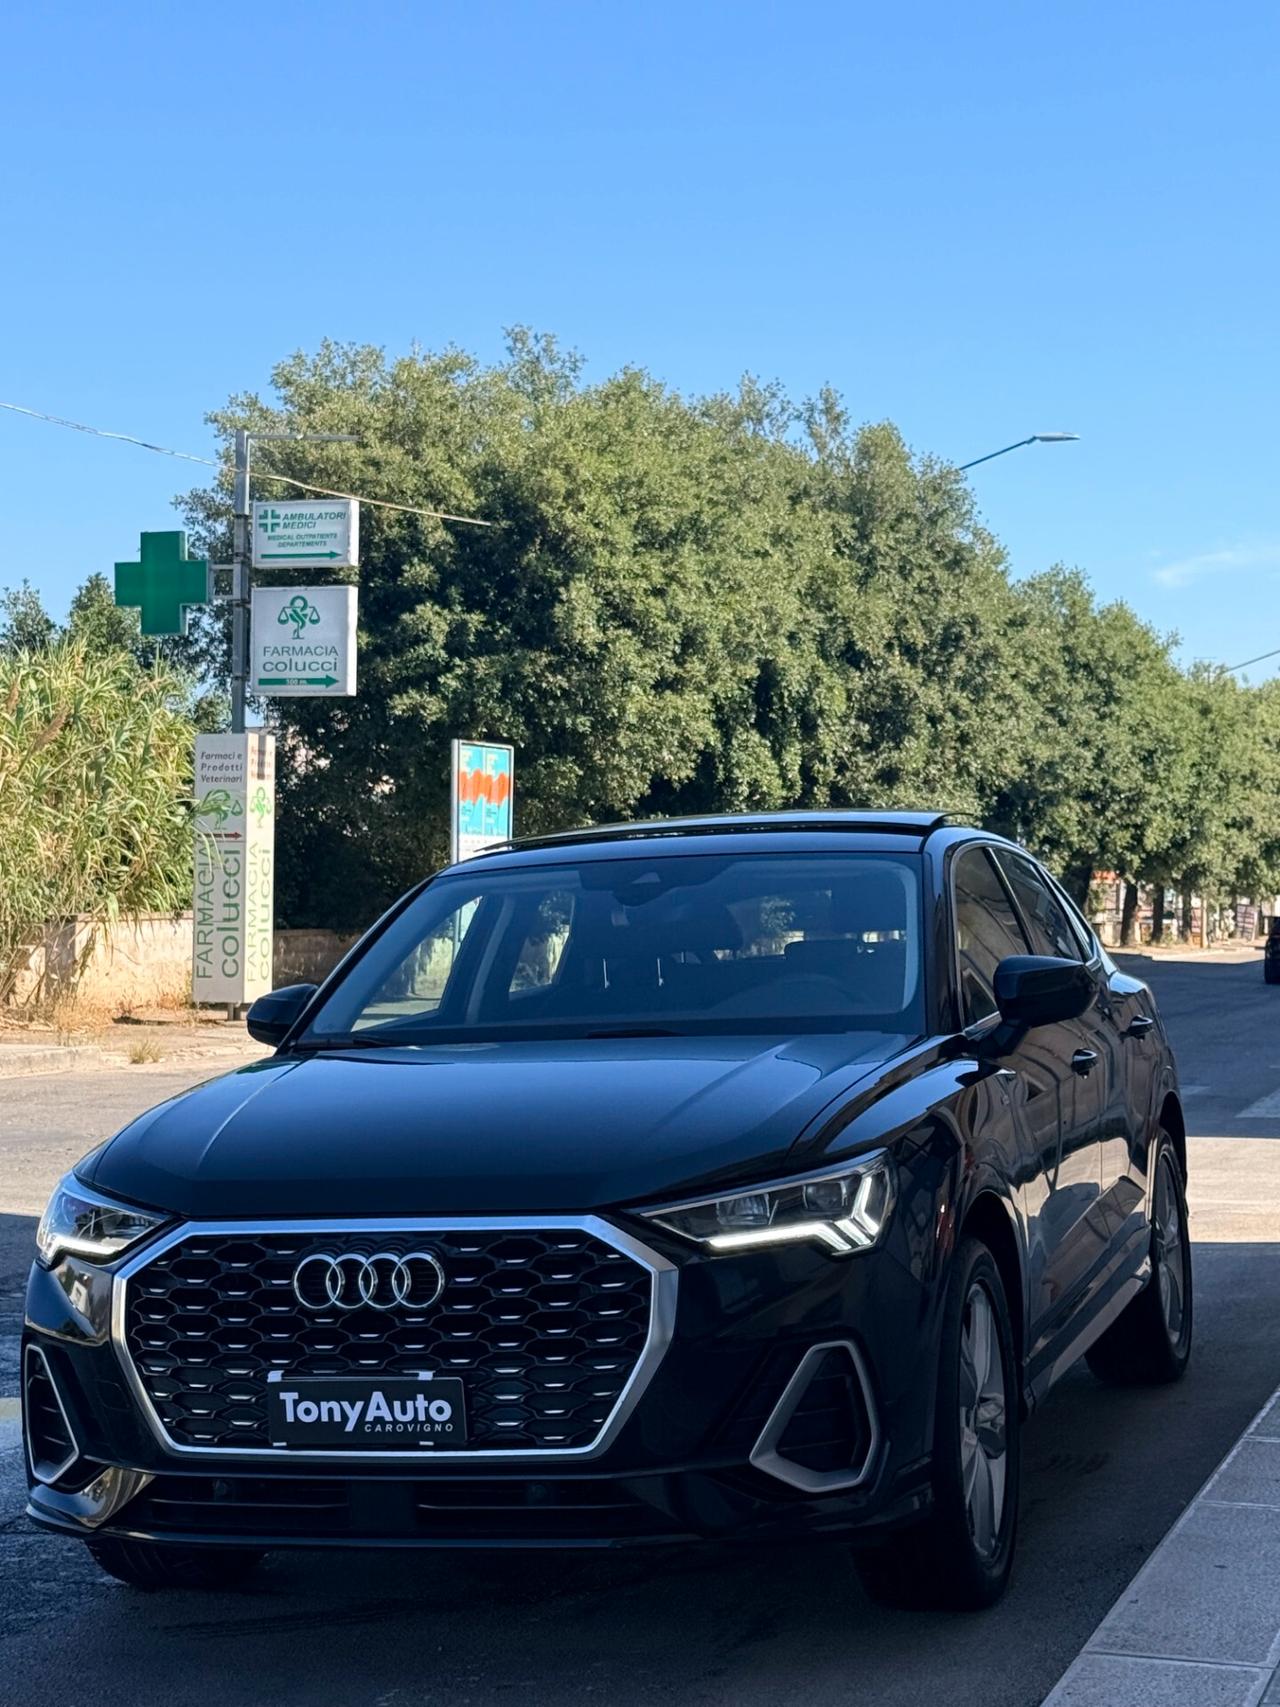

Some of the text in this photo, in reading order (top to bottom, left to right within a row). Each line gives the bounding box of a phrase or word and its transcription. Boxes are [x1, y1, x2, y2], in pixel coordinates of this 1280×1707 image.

[282, 511, 347, 521] AMBULATORI
[282, 521, 317, 530] MEDICI
[267, 533, 294, 541] MEDICAL
[263, 646, 339, 656] FARMACIA
[262, 658, 338, 672] colucci
[200, 751, 236, 760] Farmaci
[200, 763, 243, 772] Prodotti
[200, 775, 243, 783] Veterinari
[196, 841, 215, 979] FARMACIA
[216, 849, 241, 978] colucci
[247, 841, 259, 982] FARMACIA
[257, 849, 271, 981] colucci
[279, 1391, 452, 1432] TonyAuto
[364, 1424, 453, 1433] CAROVIGNO
